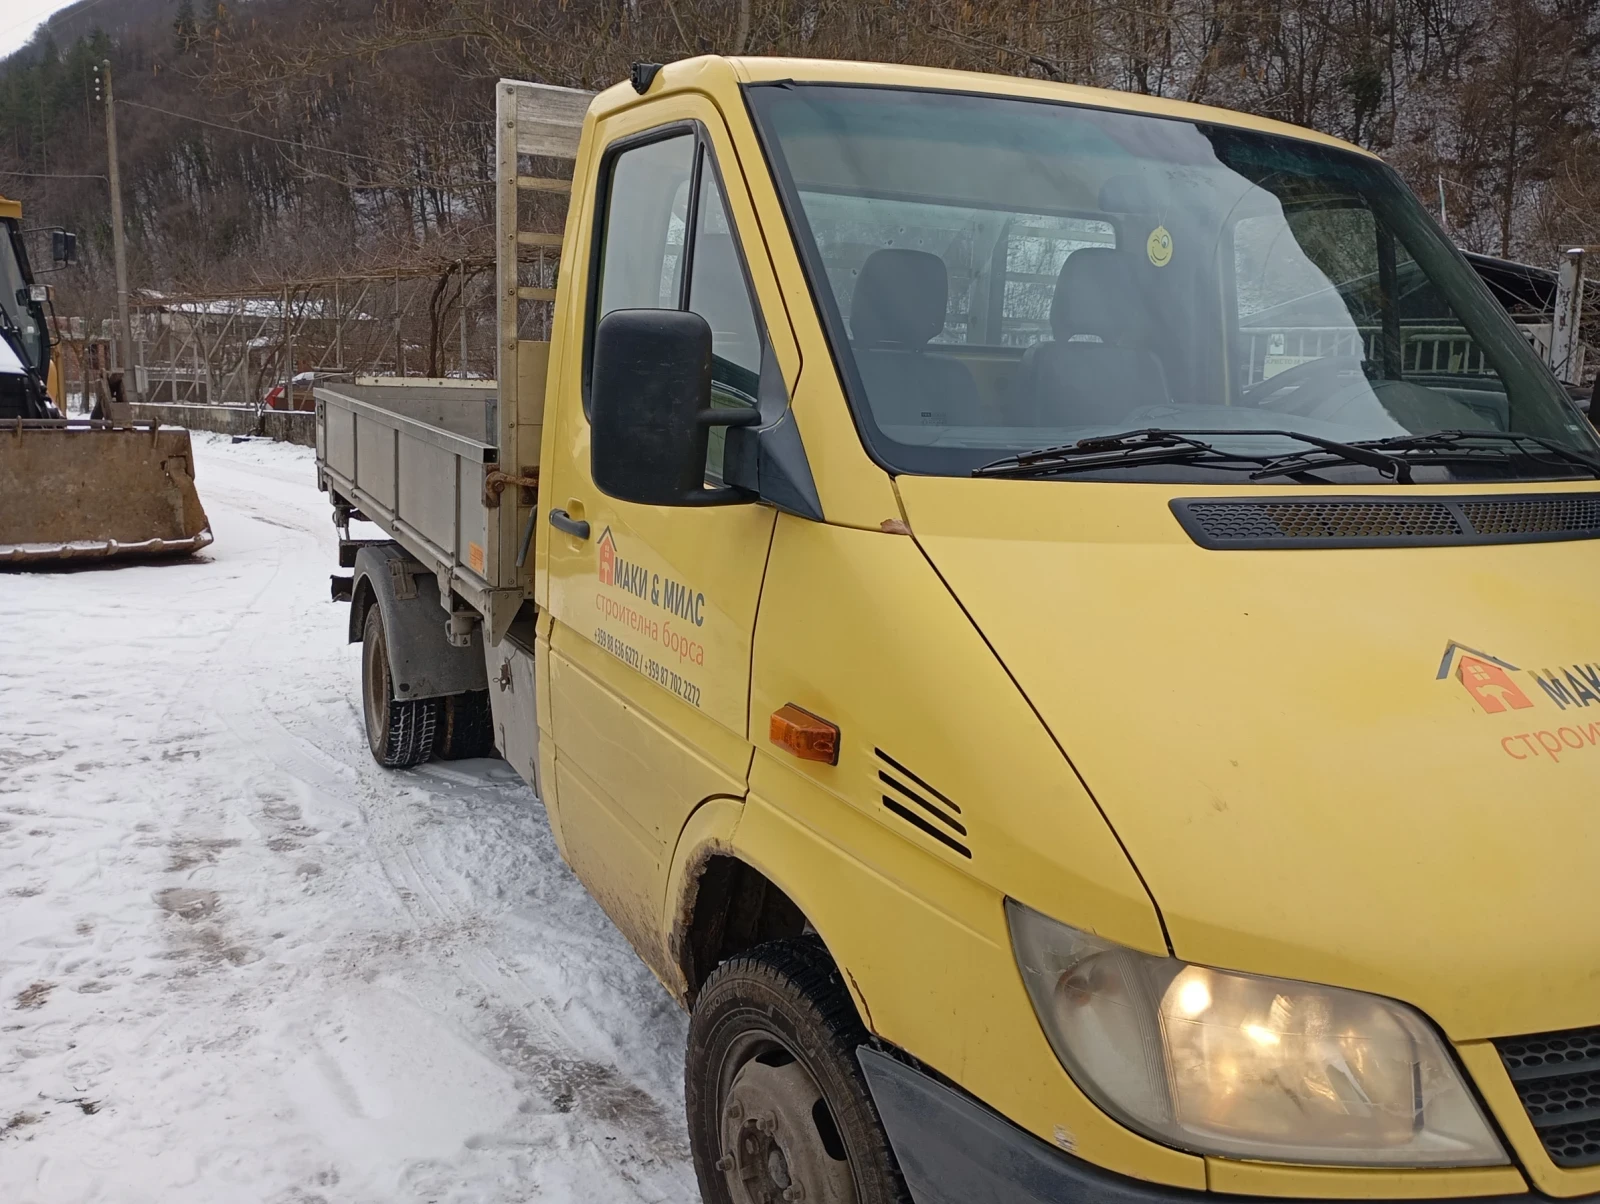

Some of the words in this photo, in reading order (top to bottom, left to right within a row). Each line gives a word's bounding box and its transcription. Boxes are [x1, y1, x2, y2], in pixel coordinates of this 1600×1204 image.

[614, 556, 648, 601] МАКИ
[651, 573, 660, 607] &
[663, 578, 705, 627] МИЛС
[595, 593, 658, 642] строителна
[662, 620, 704, 667] борса
[594, 627, 606, 648] +359
[614, 638, 624, 659] 636
[625, 645, 638, 669] 6272
[645, 658, 659, 681] +359
[660, 666, 668, 686] 87
[669, 671, 682, 696] 702
[683, 680, 701, 708] 2272
[1527, 662, 1600, 711] МАК
[1501, 721, 1600, 764] строи
